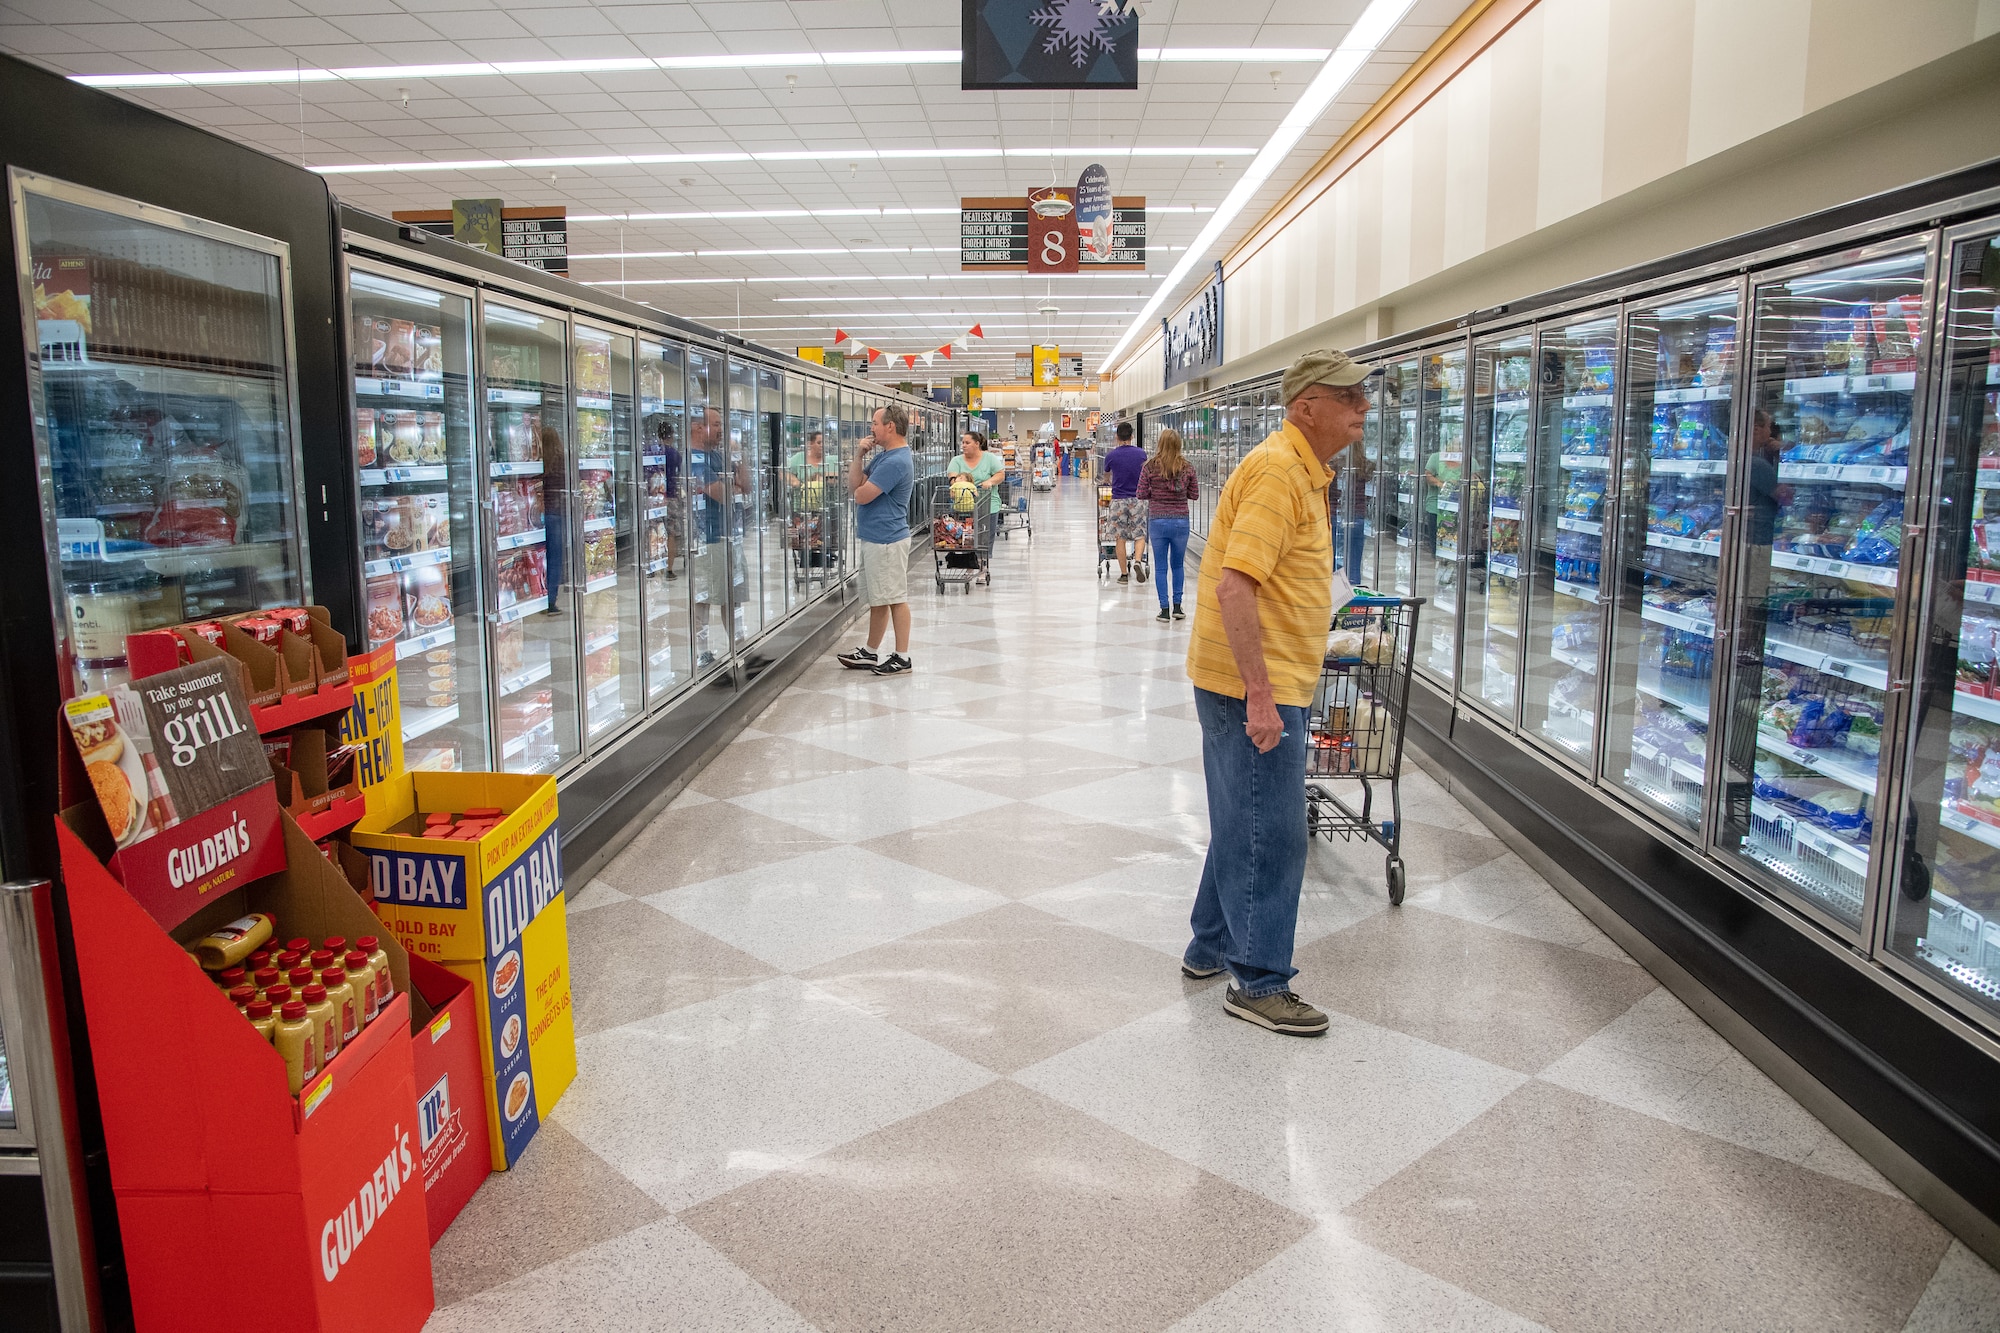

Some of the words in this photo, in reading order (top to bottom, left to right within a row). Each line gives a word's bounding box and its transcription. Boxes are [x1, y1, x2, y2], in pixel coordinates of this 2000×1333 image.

[1079, 186, 1086, 195] 25
[963, 212, 992, 222] MEATLESS
[993, 212, 1013, 222] MEATS
[1083, 205, 1091, 213] and
[1092, 204, 1100, 212] their
[504, 222, 524, 232] FROZEN
[525, 222, 541, 232] PIZZA
[963, 225, 984, 235] FROZEN
[985, 225, 997, 235] POT
[998, 225, 1012, 235] PIES
[1114, 225, 1145, 235] PRODUCTS
[504, 235, 525, 245] FROZEN
[526, 234, 545, 244] SNACK
[546, 234, 565, 244] FOODS
[963, 238, 984, 248] FROZEN
[985, 238, 1011, 248] ENTREES
[1041, 231, 1066, 266] 8
[505, 248, 525, 258] FROZEN
[526, 247, 567, 257] INTERNATIONAL
[963, 251, 984, 261] FROZEN
[985, 251, 1011, 261] DINNERS
[1110, 251, 1138, 261] GETABLES
[354, 662, 369, 678] WHO
[146, 682, 177, 705] Take
[178, 671, 223, 697] summer
[163, 700, 177, 714] by
[178, 696, 193, 710] the
[339, 676, 394, 742] AN-VERT
[164, 691, 247, 768] grill.
[358, 729, 393, 789] HEM!
[330, 789, 346, 803] SAUCES
[167, 810, 250, 889] GULDEN'S
[487, 851, 500, 870] PICK
[502, 843, 510, 858] UP
[511, 836, 519, 853] AN
[519, 823, 533, 844] EXTRA
[534, 813, 543, 832] CAN
[198, 881, 212, 896] 100%
[212, 868, 236, 889] NATURAL
[488, 864, 529, 958] OLD
[396, 920, 423, 935] OLD
[429, 922, 457, 937] BAY
[419, 942, 441, 954] on:
[536, 979, 547, 1002] THE
[548, 964, 561, 988] CAN
[500, 991, 518, 1013] CRABS
[530, 1001, 561, 1046] CONNECTS
[503, 1049, 523, 1077] SHRIMP
[510, 1107, 532, 1140] CHICKEN
[440, 1154, 452, 1178] you
[321, 1122, 413, 1283] GULDEN'S
